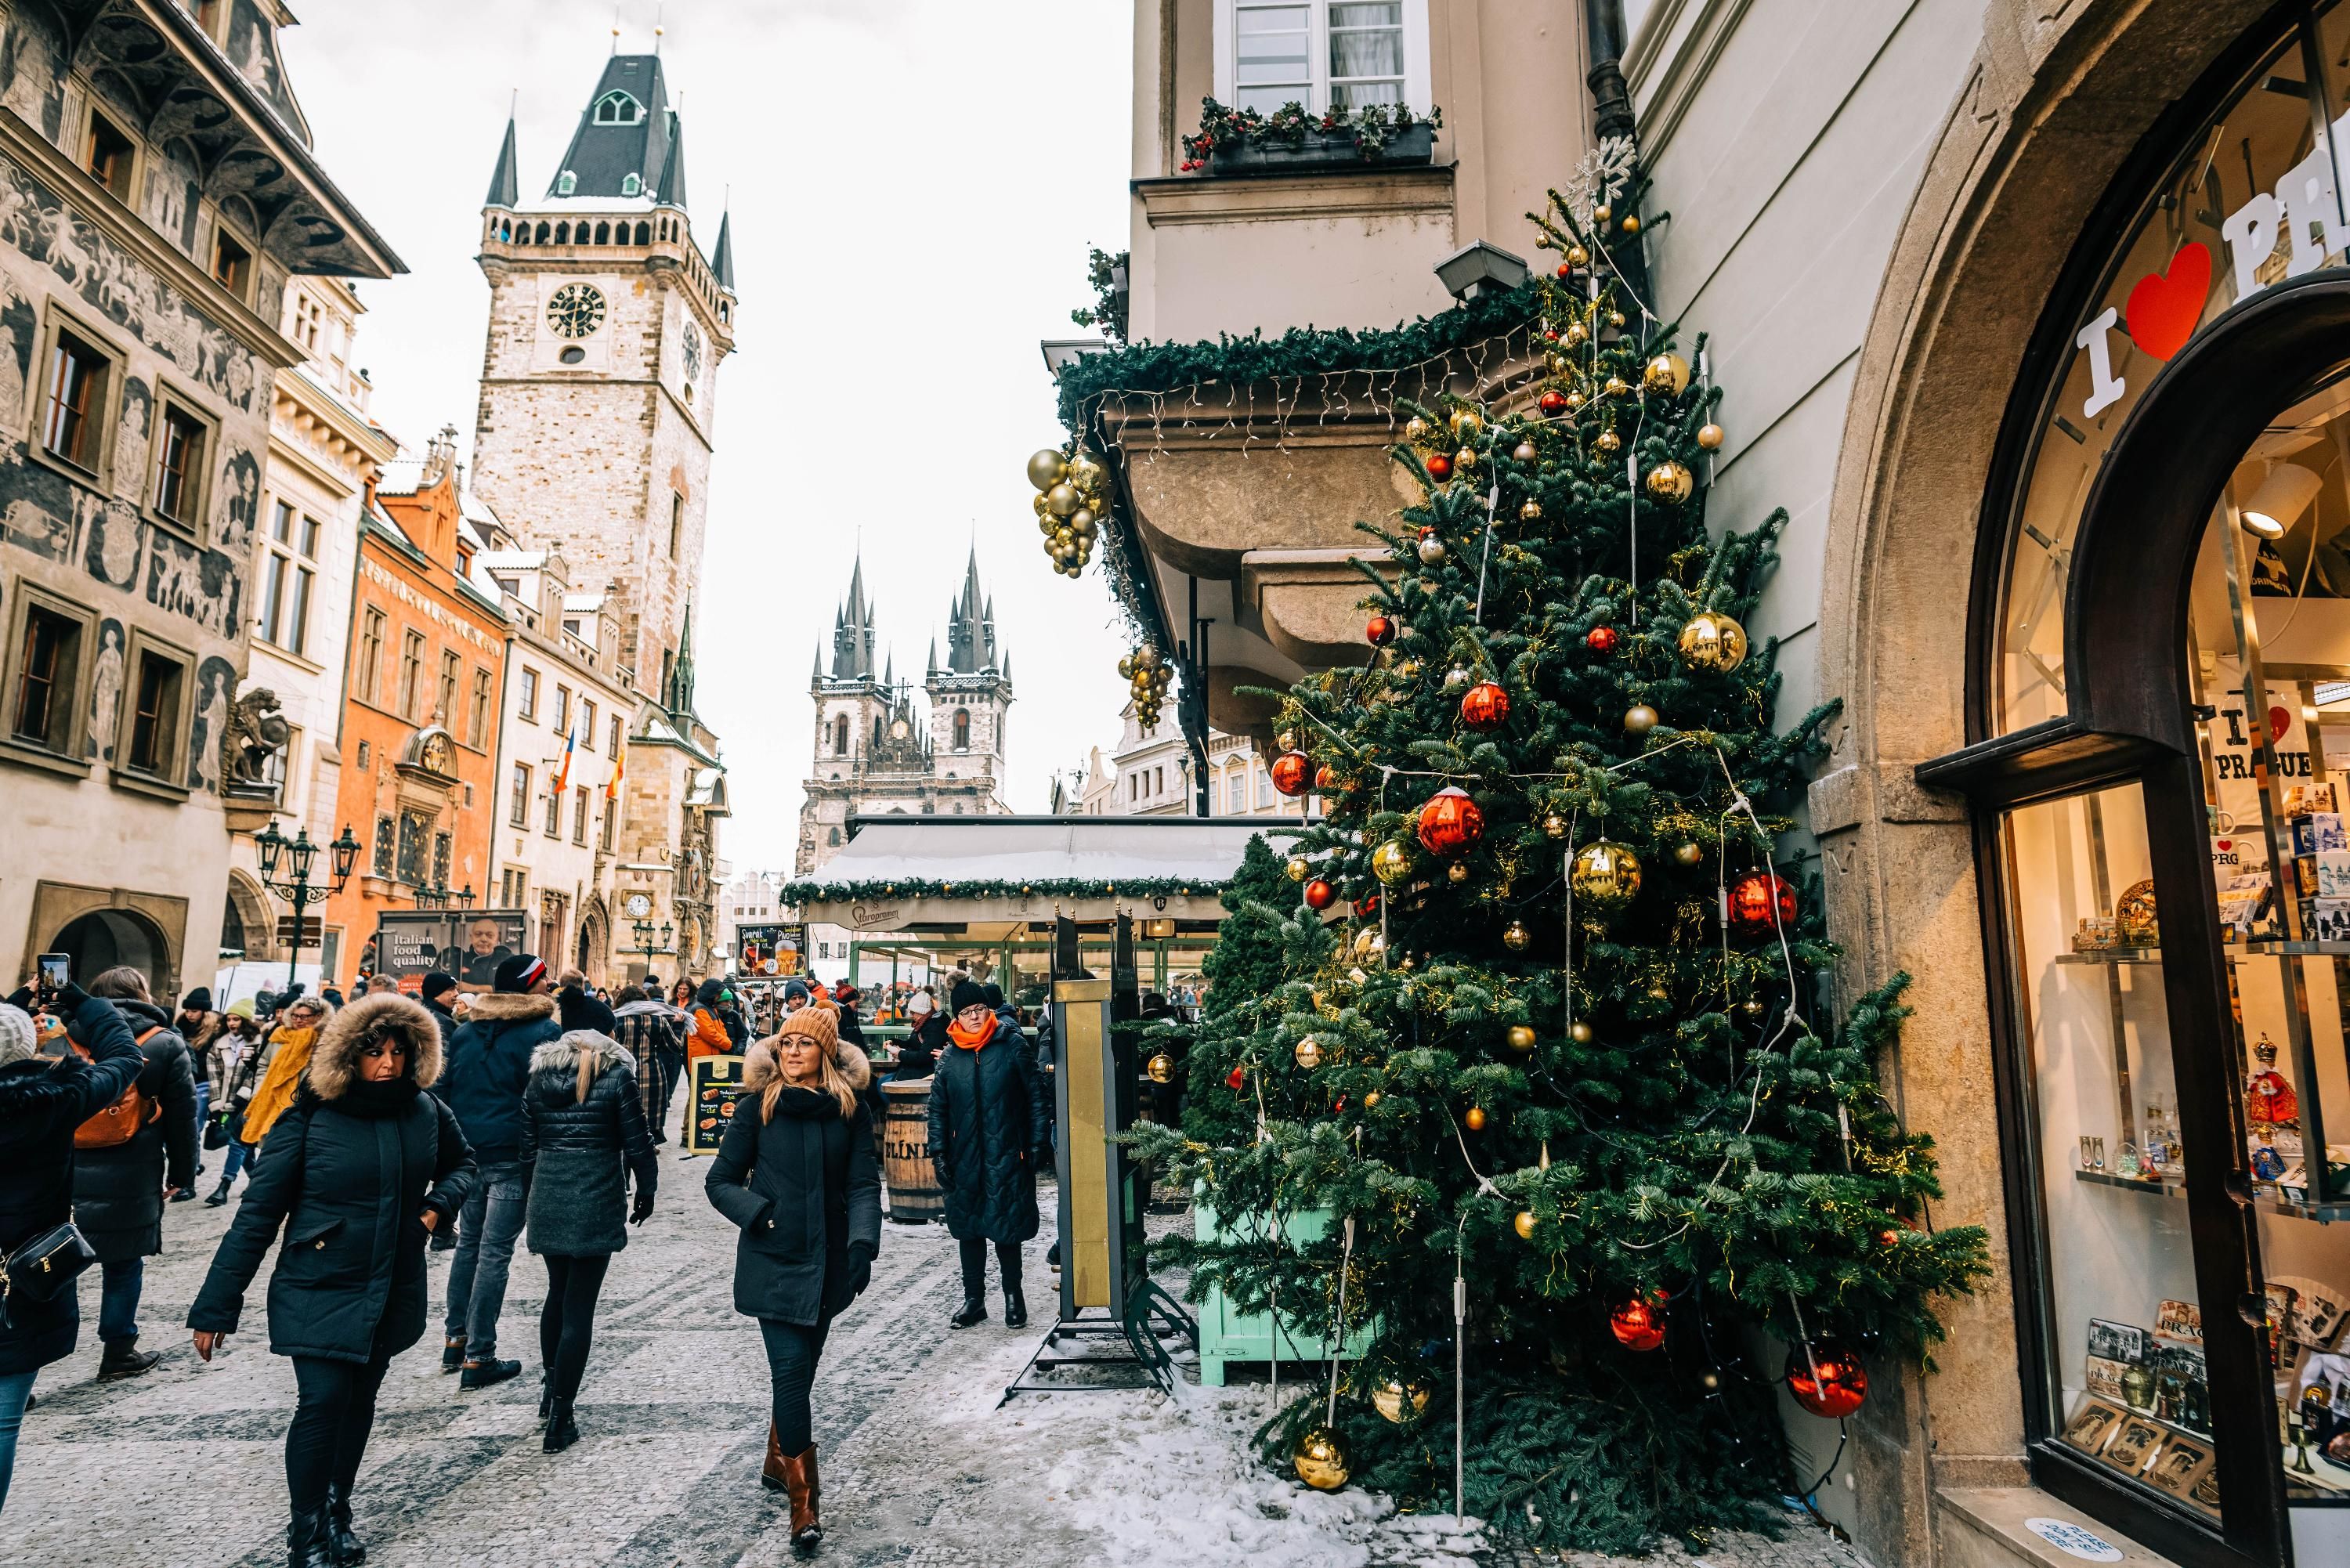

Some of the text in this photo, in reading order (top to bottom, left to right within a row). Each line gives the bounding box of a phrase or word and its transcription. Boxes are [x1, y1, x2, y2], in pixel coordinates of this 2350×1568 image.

[2077, 108, 2350, 418] I PR
[2221, 709, 2248, 746] I
[2211, 853, 2239, 865] PRG
[1157, 899, 1165, 908] B
[852, 906, 900, 929] Staropramen
[394, 934, 434, 945] Italian
[777, 930, 790, 940] Pivo
[393, 945, 421, 955] food
[393, 956, 436, 968] quality
[766, 961, 775, 971] 69
[2092, 1334, 2139, 1350] PRAGUE
[2041, 1531, 2076, 1549] HERE
[2067, 1526, 2113, 1551] PLEASE
